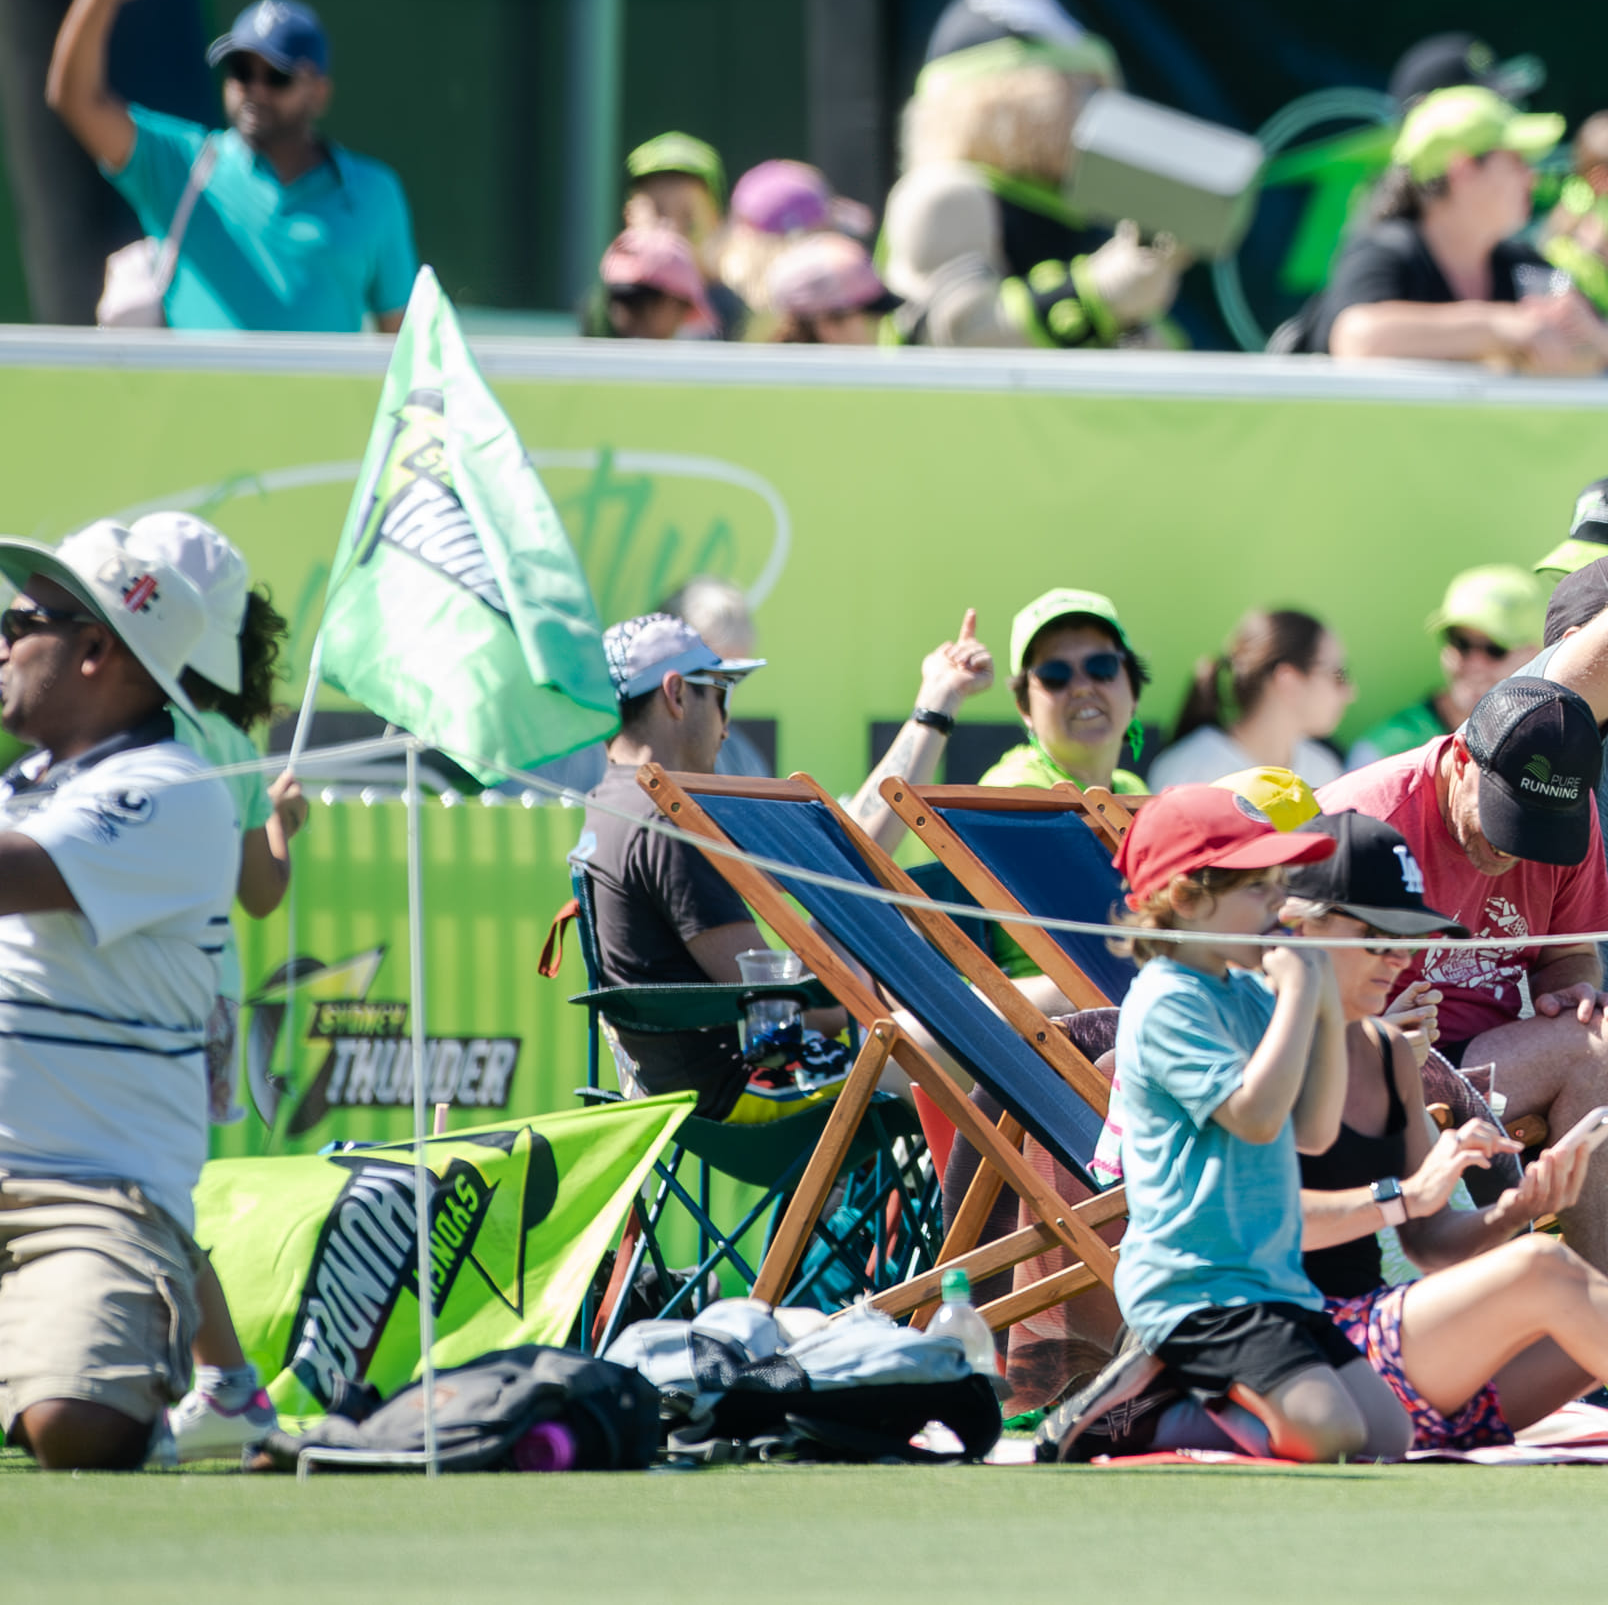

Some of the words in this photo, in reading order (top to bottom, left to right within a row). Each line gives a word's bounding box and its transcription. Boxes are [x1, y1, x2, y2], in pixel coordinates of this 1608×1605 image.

[1520, 777, 1580, 800] RUNNING
[1550, 774, 1582, 789] PURE
[326, 1036, 518, 1106] THUNDER
